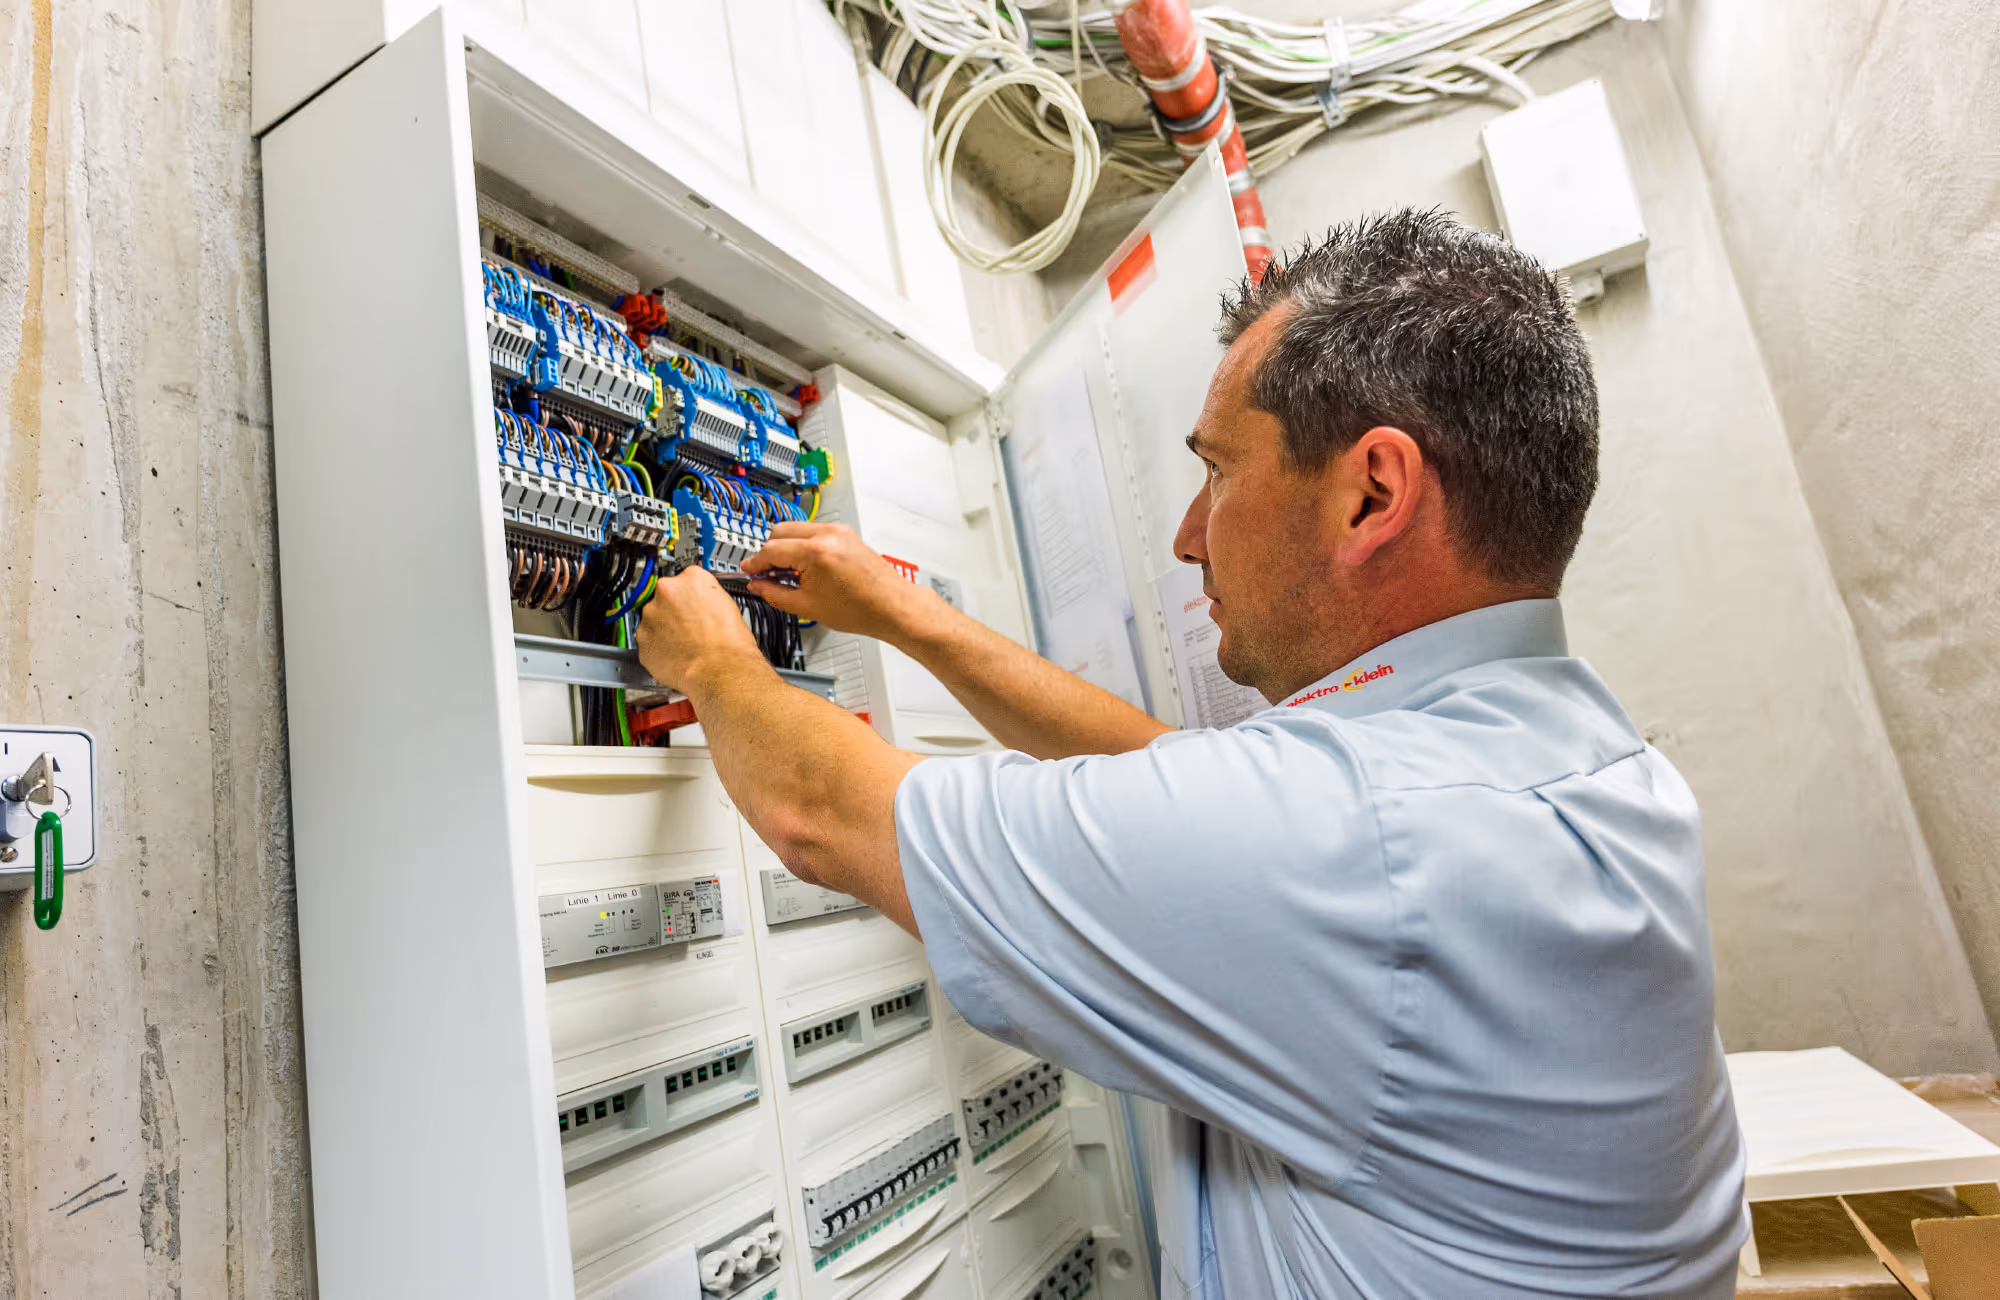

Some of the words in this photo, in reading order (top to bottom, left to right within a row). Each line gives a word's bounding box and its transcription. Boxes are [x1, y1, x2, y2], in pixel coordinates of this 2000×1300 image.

[1353, 664, 1394, 686] klein
[567, 896, 590, 906] Linie
[594, 895, 600, 903] 1
[607, 892, 628, 901] Linie
[631, 889, 638, 897] 0
[663, 890, 681, 899] GIRA
[595, 945, 610, 956] KNX
